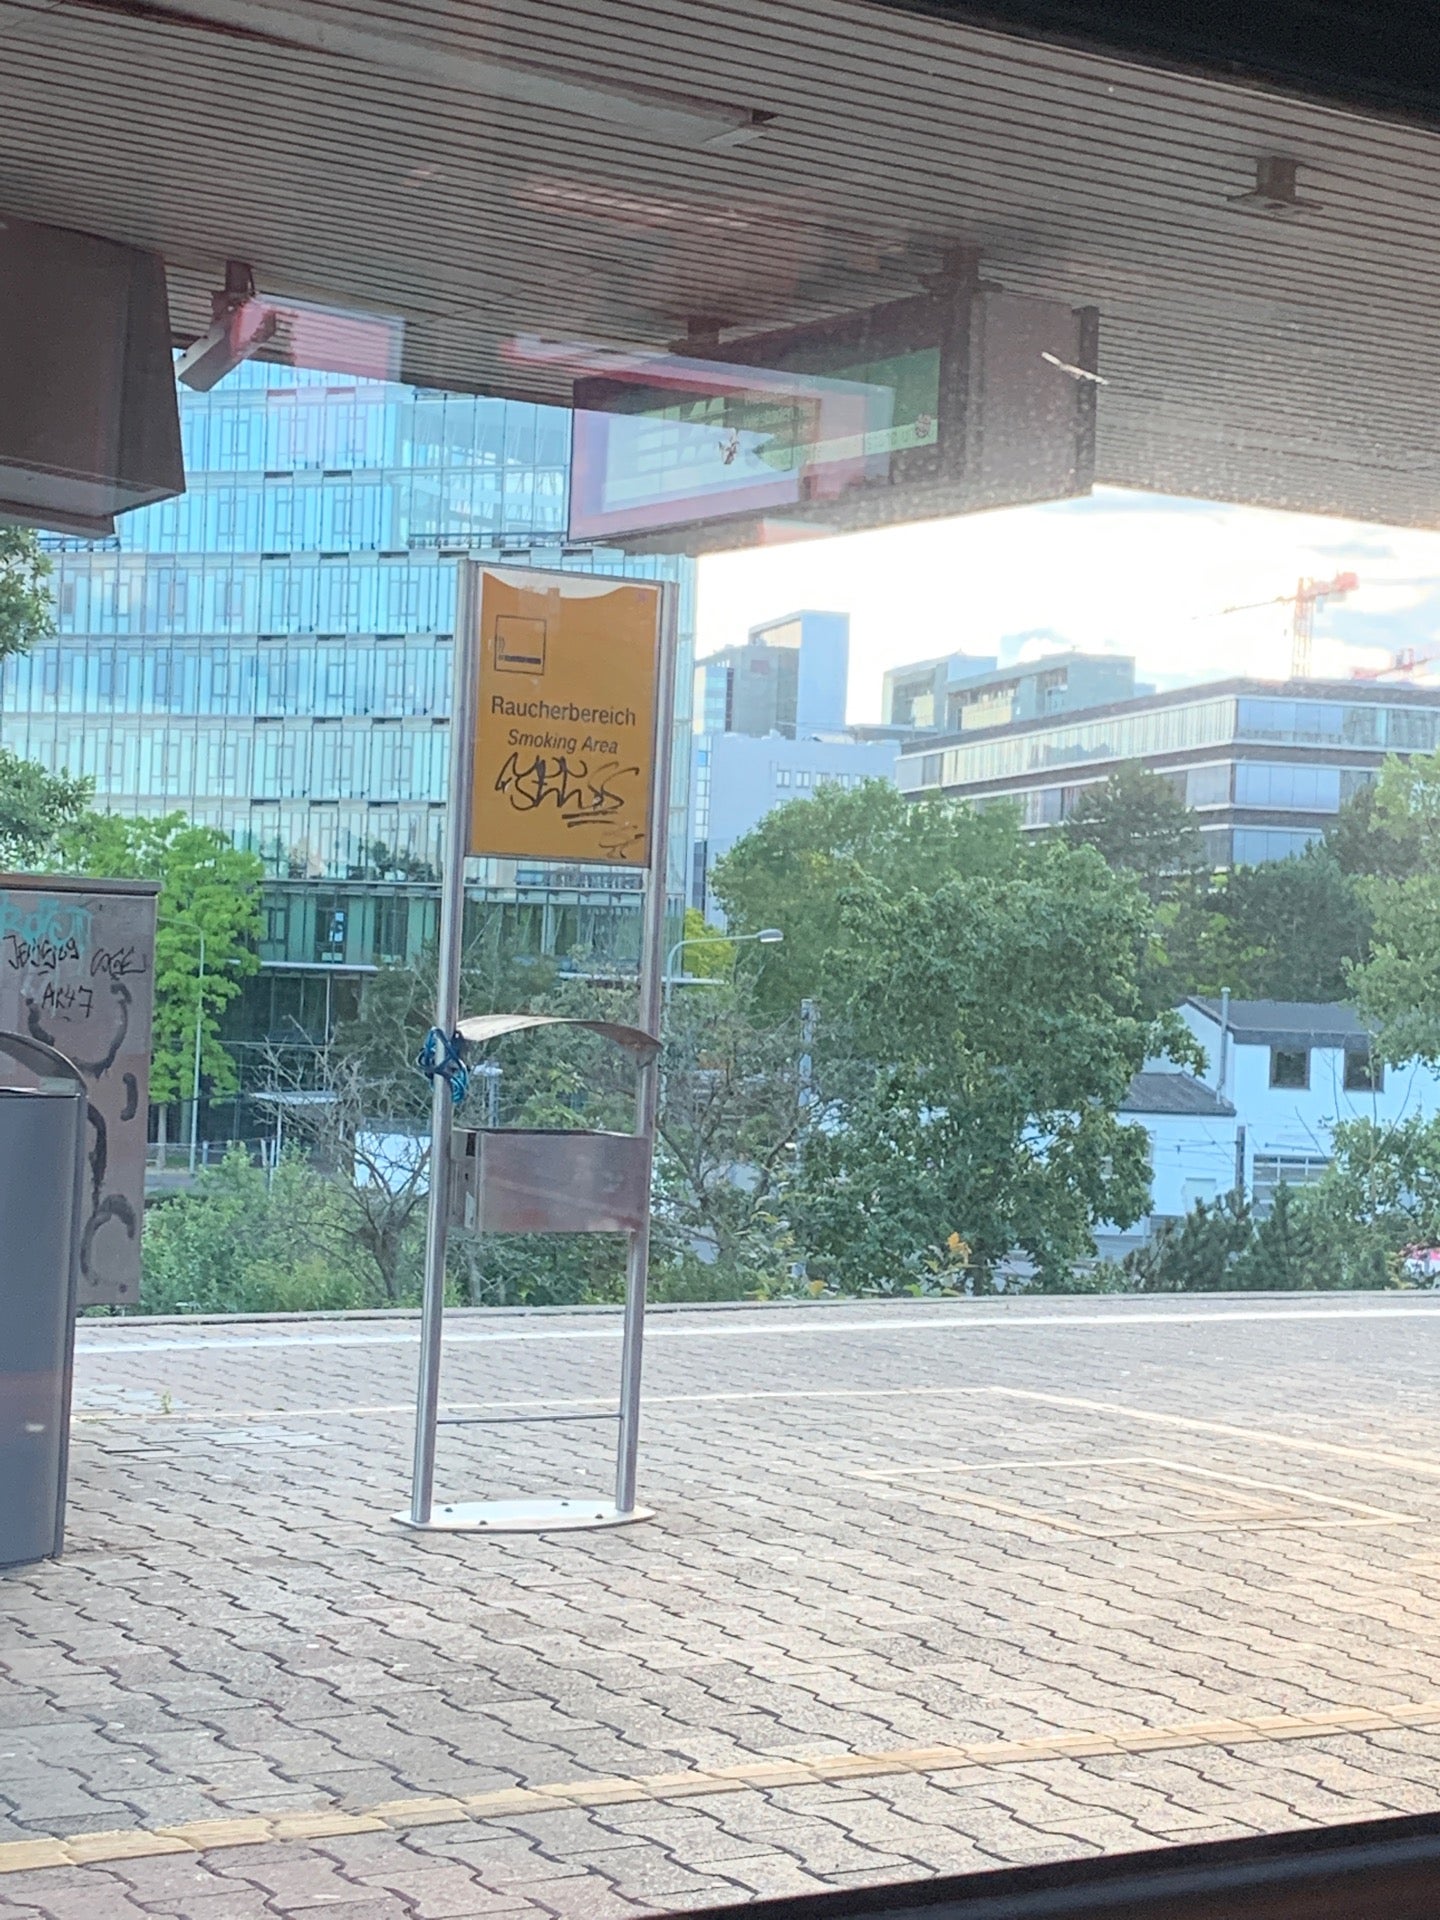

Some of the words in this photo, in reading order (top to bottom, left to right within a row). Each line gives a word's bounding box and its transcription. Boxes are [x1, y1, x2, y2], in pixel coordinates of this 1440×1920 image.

[491, 695, 636, 726] Raucherbereich
[508, 729, 576, 753] Smoking
[581, 735, 618, 754] Area
